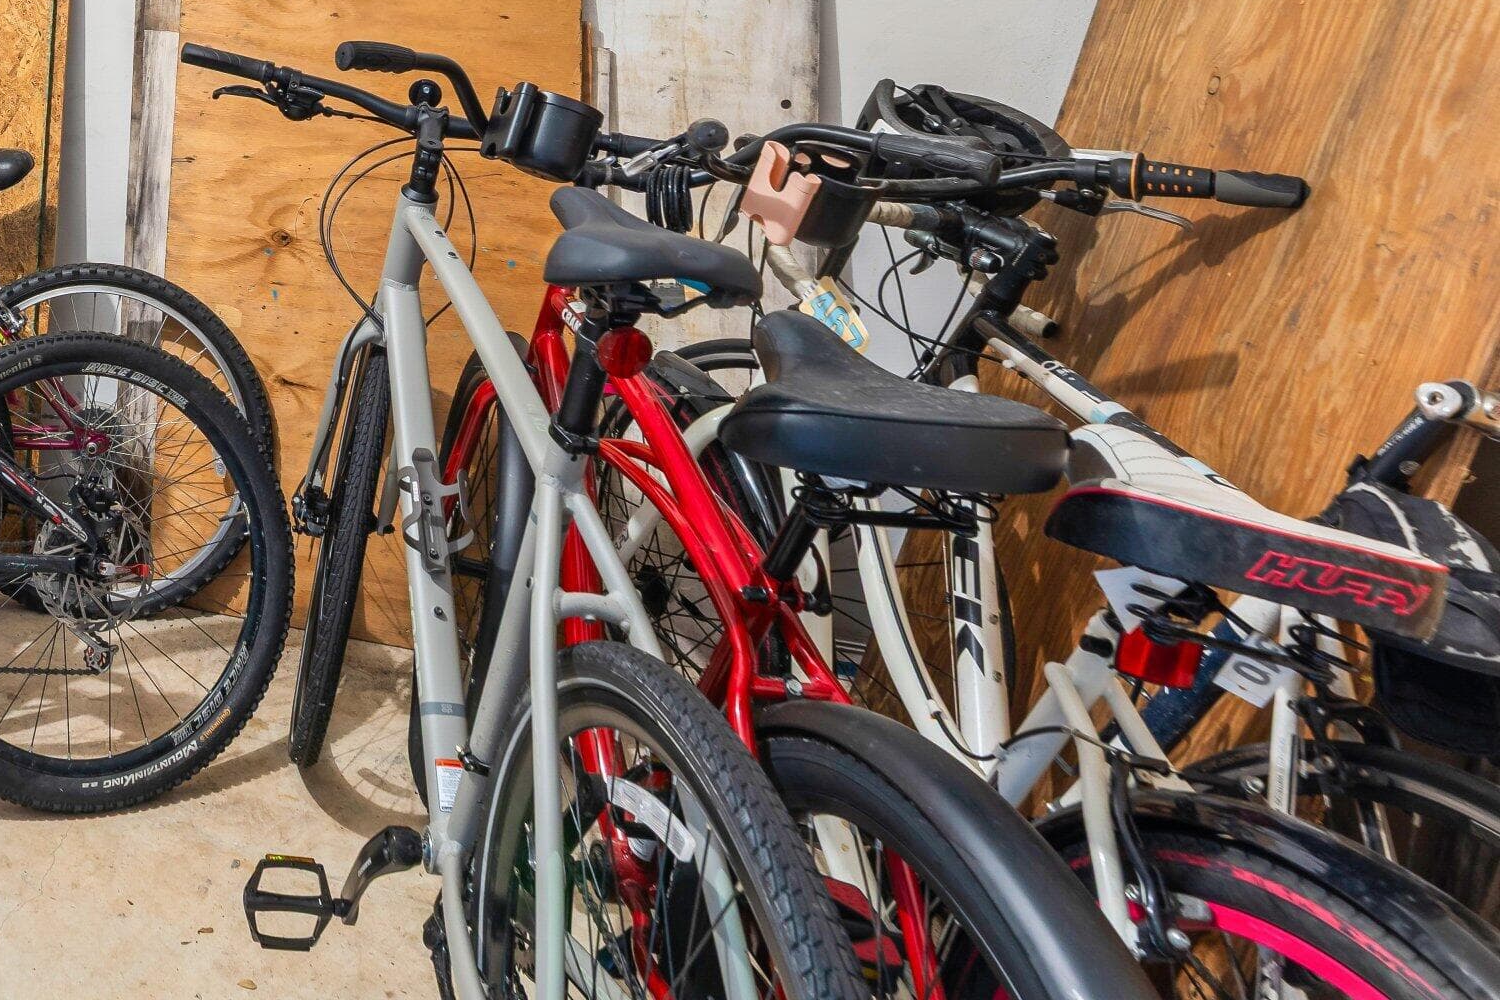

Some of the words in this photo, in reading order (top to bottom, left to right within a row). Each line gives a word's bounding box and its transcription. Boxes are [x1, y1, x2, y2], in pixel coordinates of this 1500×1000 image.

[85, 362, 131, 377] RACE
[130, 371, 168, 394] DISC
[1244, 550, 1433, 616] HUFFY
[195, 690, 225, 730] DISC
